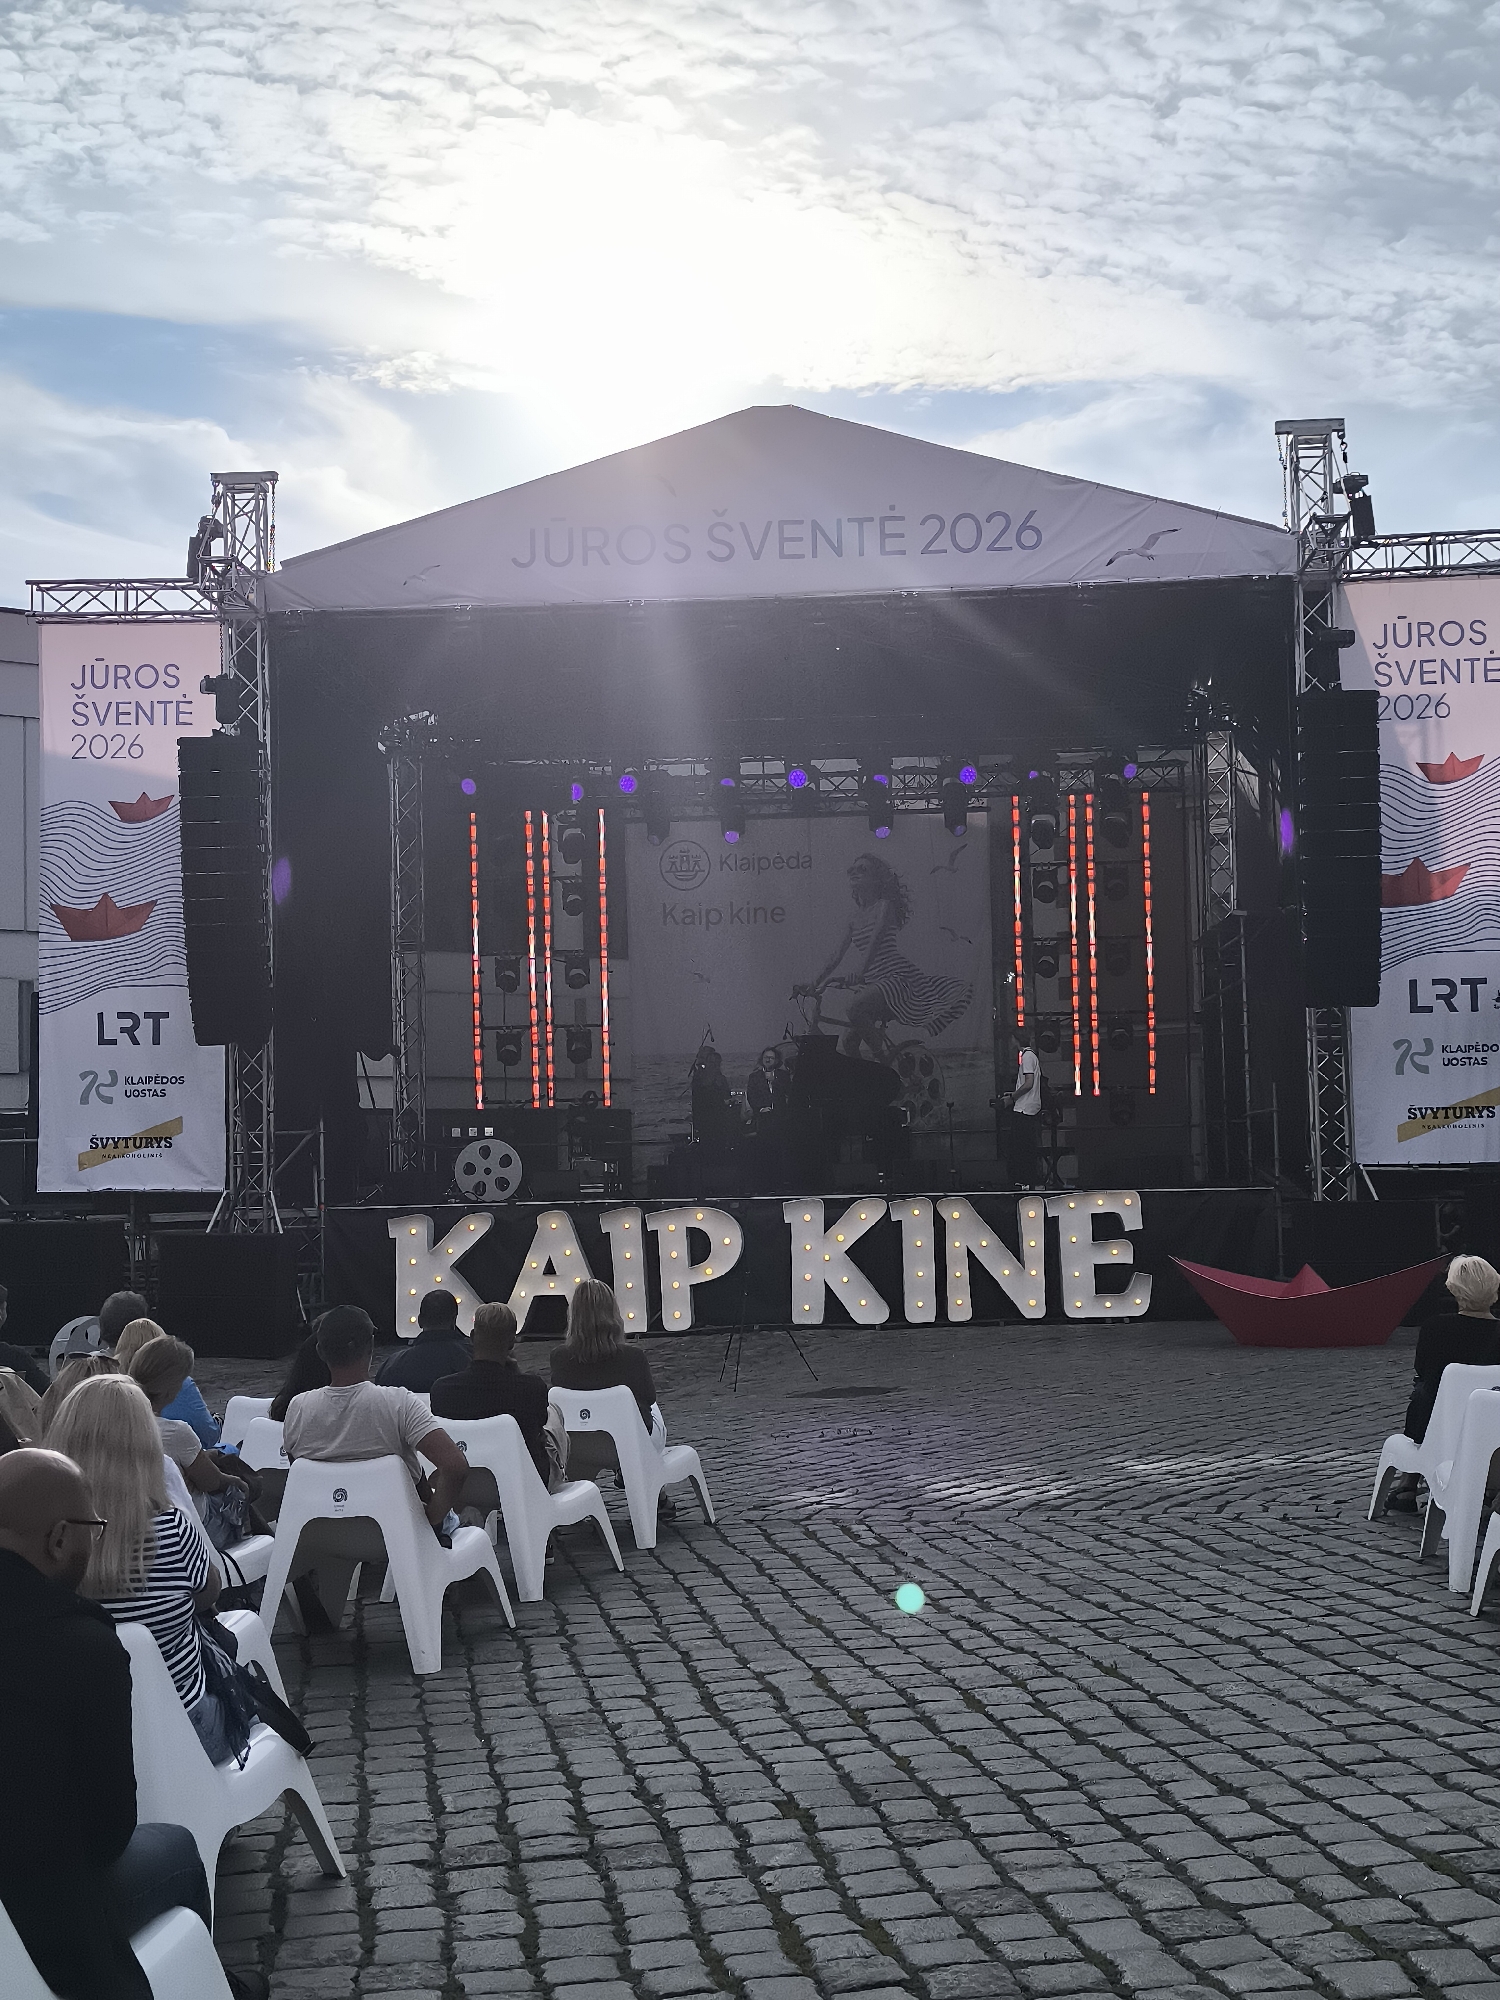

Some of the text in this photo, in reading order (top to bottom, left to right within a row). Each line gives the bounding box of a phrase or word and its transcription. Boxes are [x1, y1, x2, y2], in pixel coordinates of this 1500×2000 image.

[511, 504, 1043, 569] JŪROS ŠVENTĖ 2026
[1373, 616, 1487, 649] JŪROS
[71, 657, 180, 690] JŪROS
[1374, 650, 1500, 687] ŠVENTĖ
[71, 693, 193, 727] ŠVENTĖ
[1377, 693, 1450, 720] 2026
[71, 733, 144, 760] 2026
[719, 850, 813, 874] Klaipėda
[662, 901, 786, 931] Kaip kine
[1408, 977, 1488, 1014] LRT
[97, 1012, 170, 1046] LRT
[1442, 1056, 1489, 1067] UOSTAS
[124, 1074, 185, 1085] KLAIPĖDOS
[124, 1088, 166, 1098] UOSTAS
[1407, 1105, 1496, 1120] ŠVYTURYS
[89, 1134, 173, 1150] ŠVYTURYS
[387, 1190, 1153, 1339] KAIP KINE
